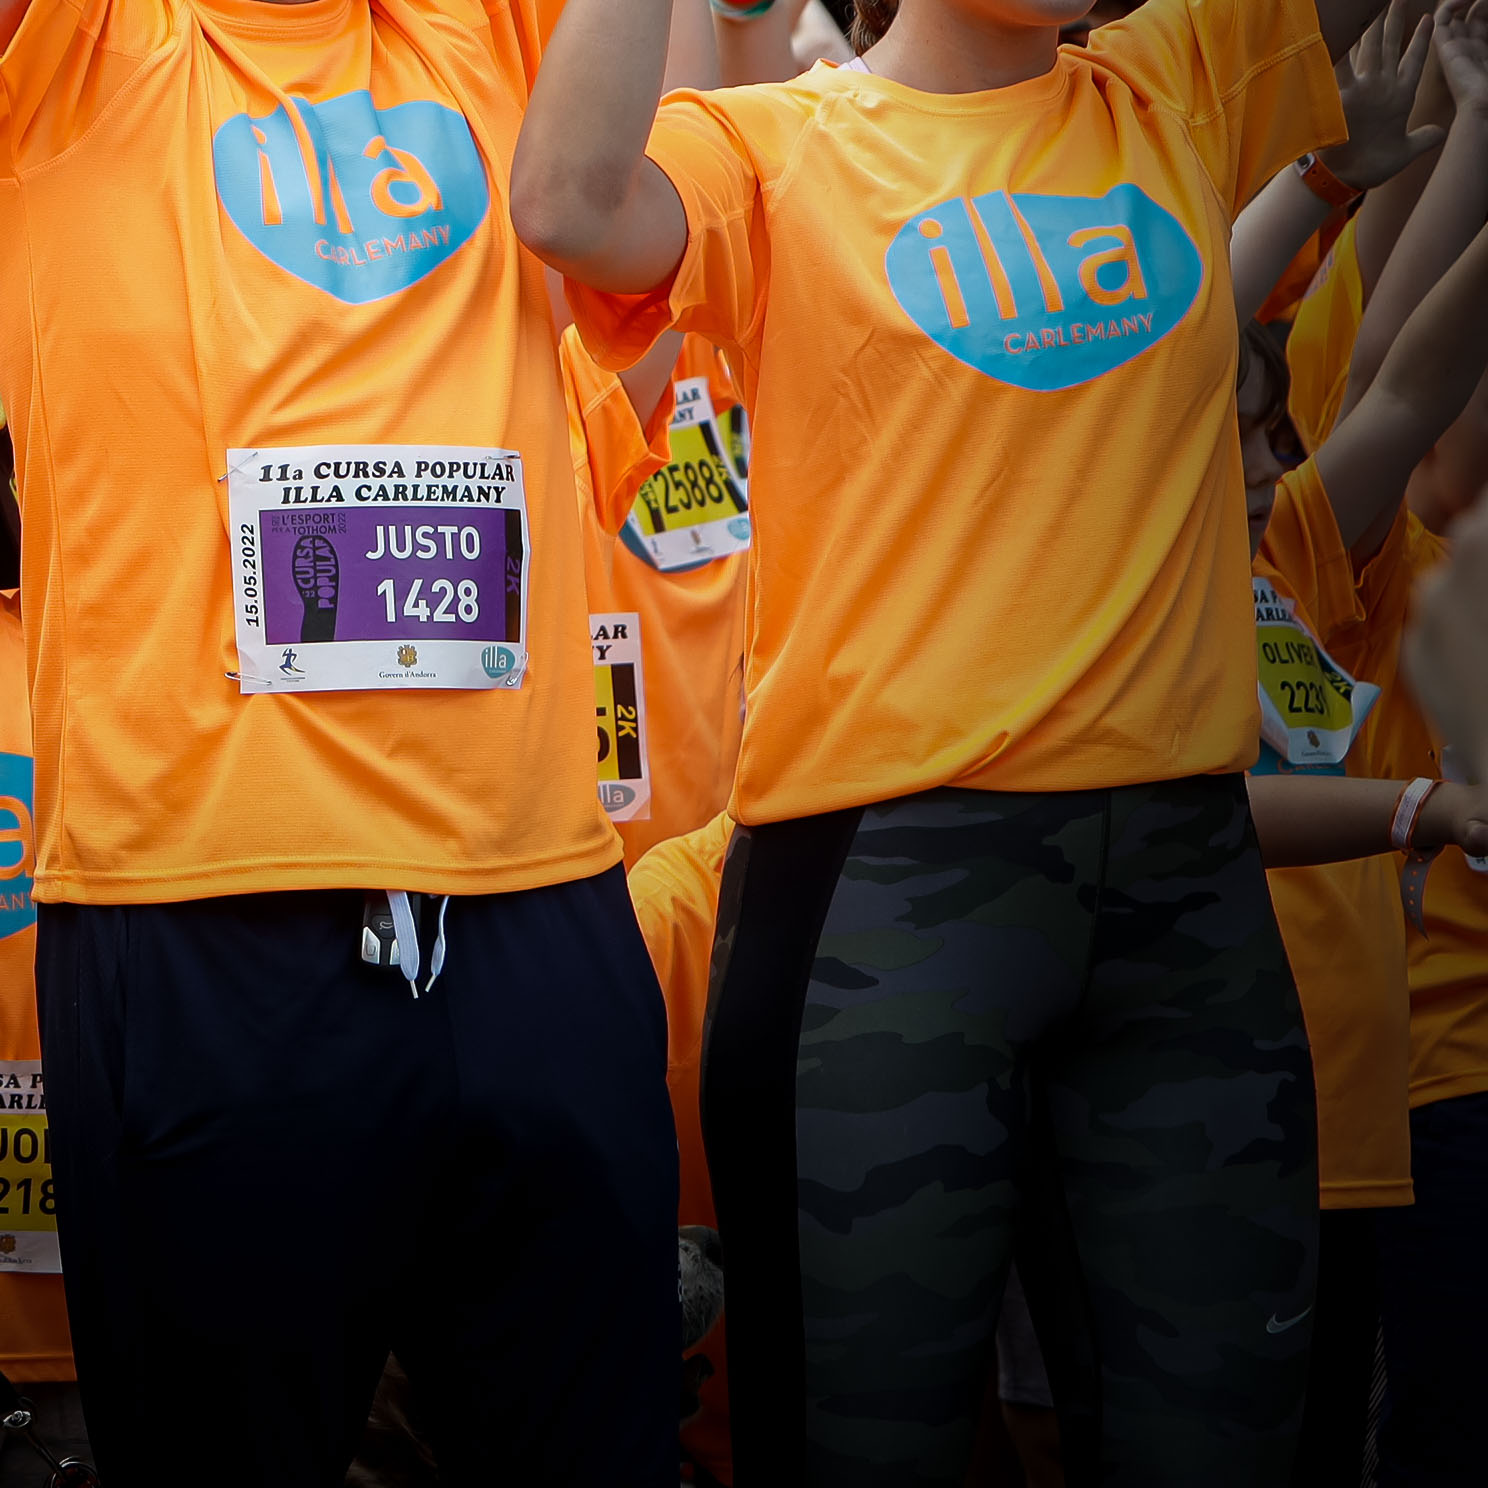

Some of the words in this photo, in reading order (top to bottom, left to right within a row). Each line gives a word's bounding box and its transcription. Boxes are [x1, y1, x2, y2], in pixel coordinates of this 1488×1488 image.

[251, 96, 444, 234] illa
[315, 224, 452, 267] CARLEMANY
[919, 190, 1147, 328] illa
[1004, 313, 1154, 355] CARLEMANY
[259, 465, 303, 482] 11a
[314, 461, 406, 480] CURSA
[415, 461, 516, 482] POPULAR
[653, 458, 724, 515] 2588
[281, 485, 345, 504] ILLA
[355, 483, 506, 504] CARLEMANY
[282, 513, 336, 526] L'ESPORT
[292, 525, 337, 536] TOTHOM
[365, 525, 481, 560] JUSTO
[240, 523, 260, 628] 15.05.2022
[295, 537, 315, 589] CURSA
[506, 557, 520, 596] 2K
[377, 579, 479, 624] 1428
[379, 671, 404, 679] Govern
[485, 645, 507, 668] illa
[617, 703, 637, 738] 2K
[599, 784, 624, 804] lla
